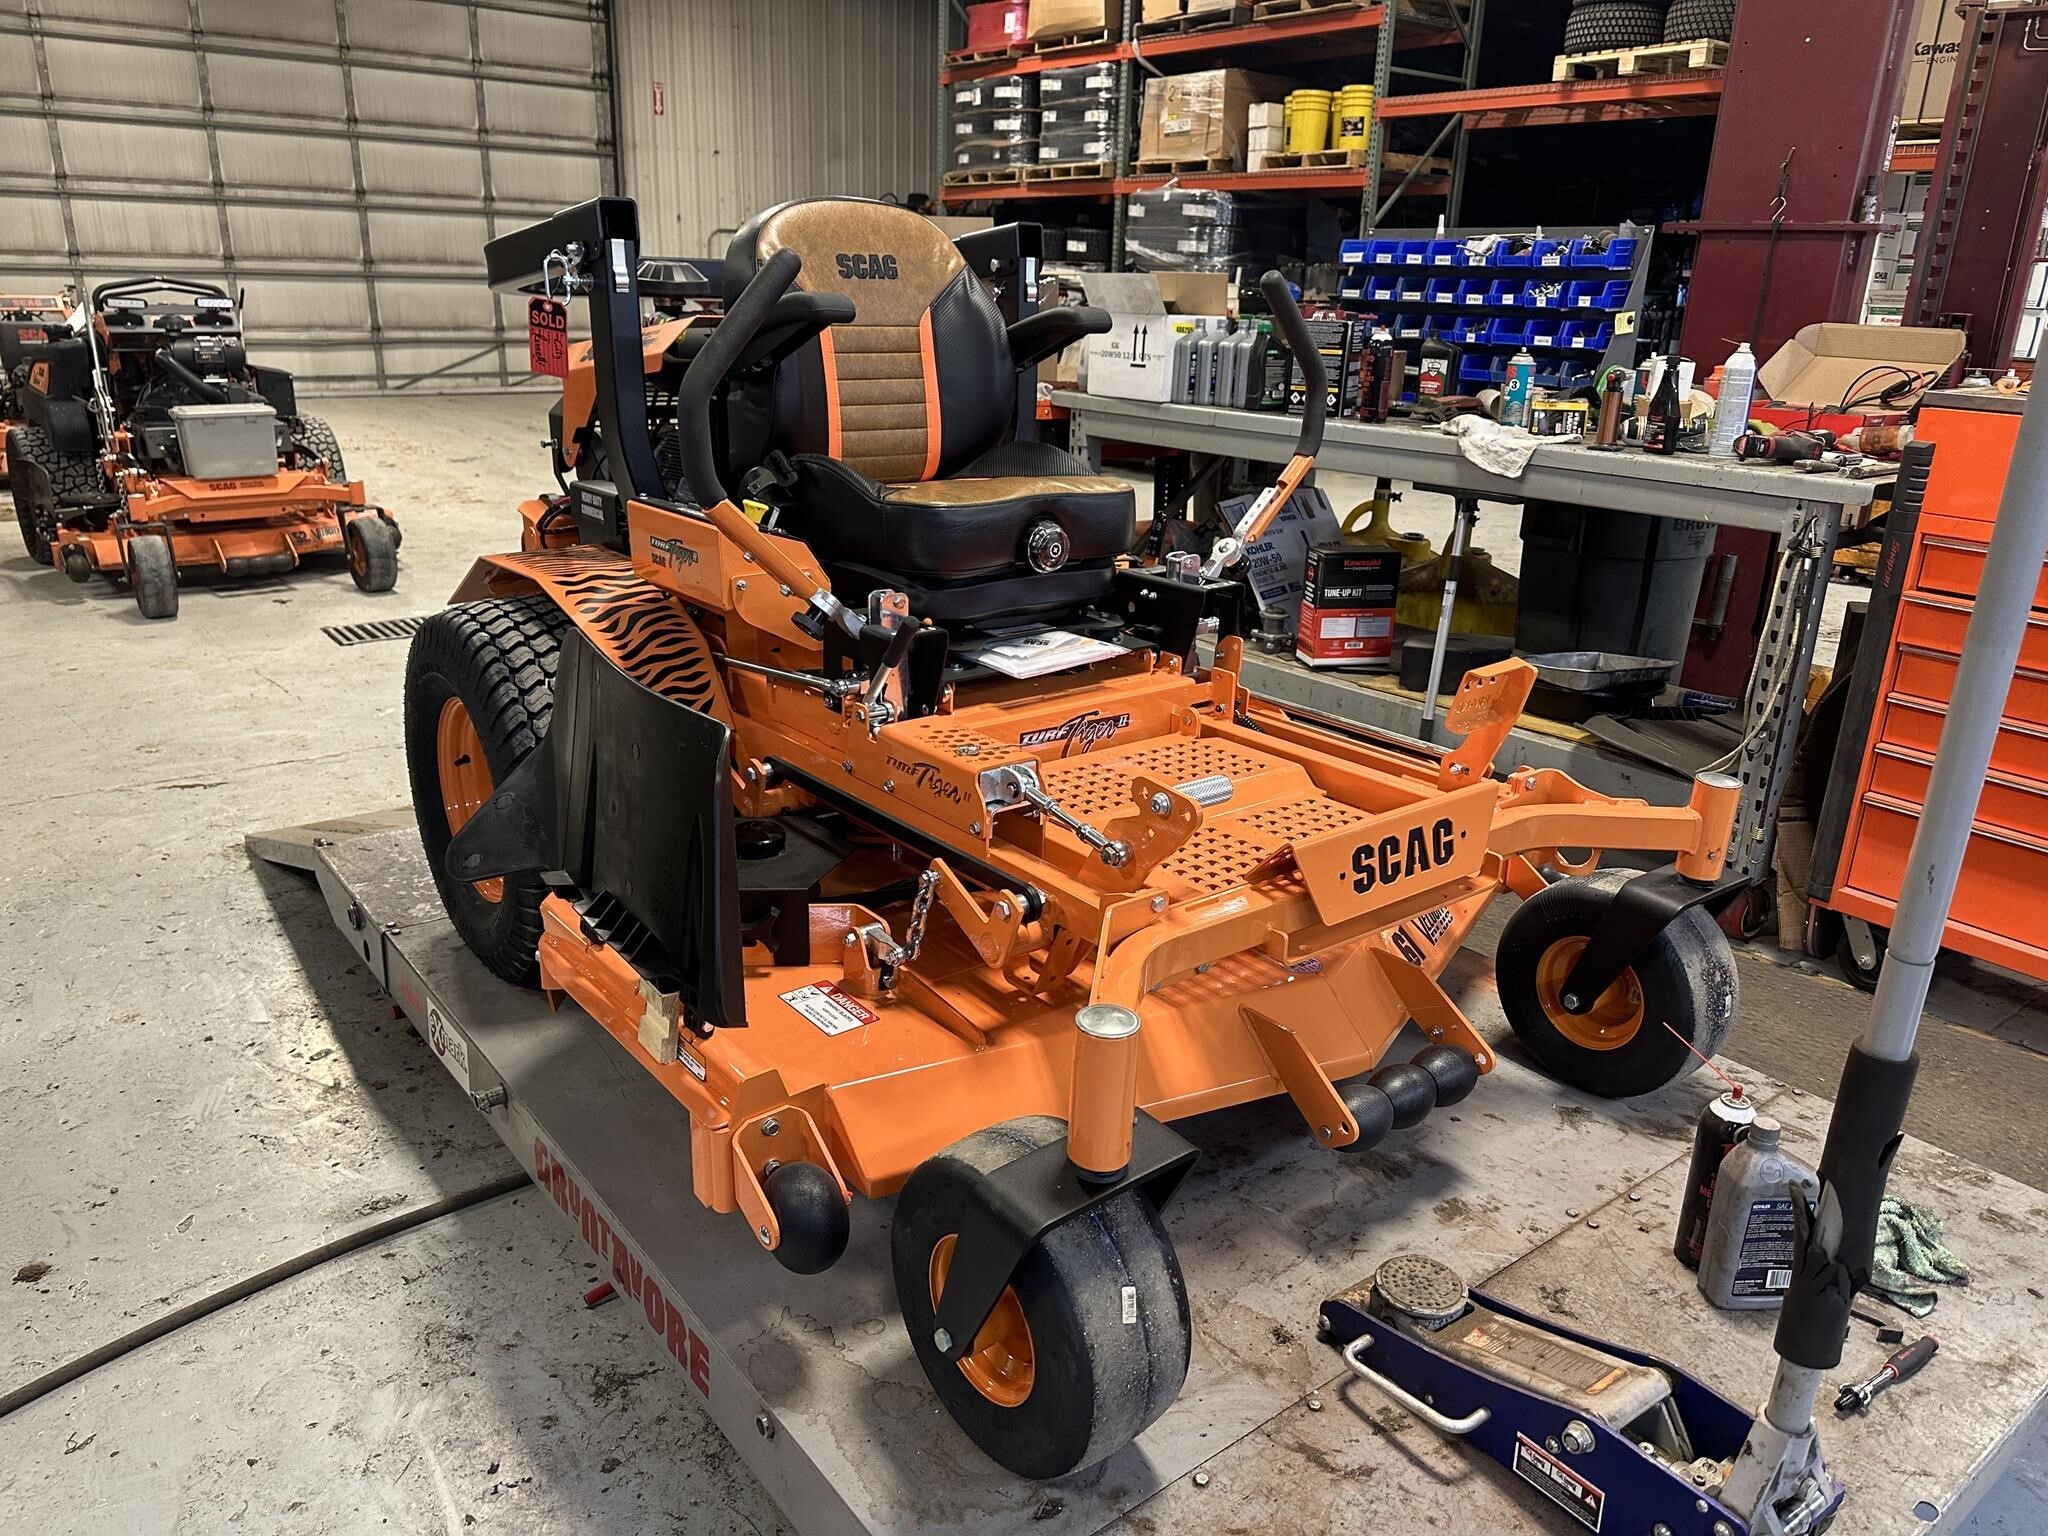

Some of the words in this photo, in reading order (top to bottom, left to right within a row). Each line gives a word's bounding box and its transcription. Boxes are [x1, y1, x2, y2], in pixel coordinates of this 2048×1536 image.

[1926, 56, 1958, 65] ENGIN
[836, 253, 898, 279] SCAG
[532, 310, 565, 329] SOLD
[18, 329, 48, 341] SCA
[1511, 380, 1518, 389] 3
[208, 483, 237, 491] SCAG
[651, 538, 671, 550] TURF
[1246, 542, 1274, 556] KOHLER
[1252, 552, 1283, 569] 20W-50
[1324, 588, 1351, 597] TUNE-UP
[1352, 588, 1363, 597] KIT
[1021, 726, 1069, 746] TURF
[1059, 710, 1118, 759] Tiger
[886, 755, 919, 777] TURF
[912, 762, 961, 804] Tiger
[1351, 817, 1454, 894] SCAG
[1391, 925, 1427, 967] 61
[830, 993, 870, 1019] DANGER
[534, 1136, 711, 1401] GRUNTAVORE
